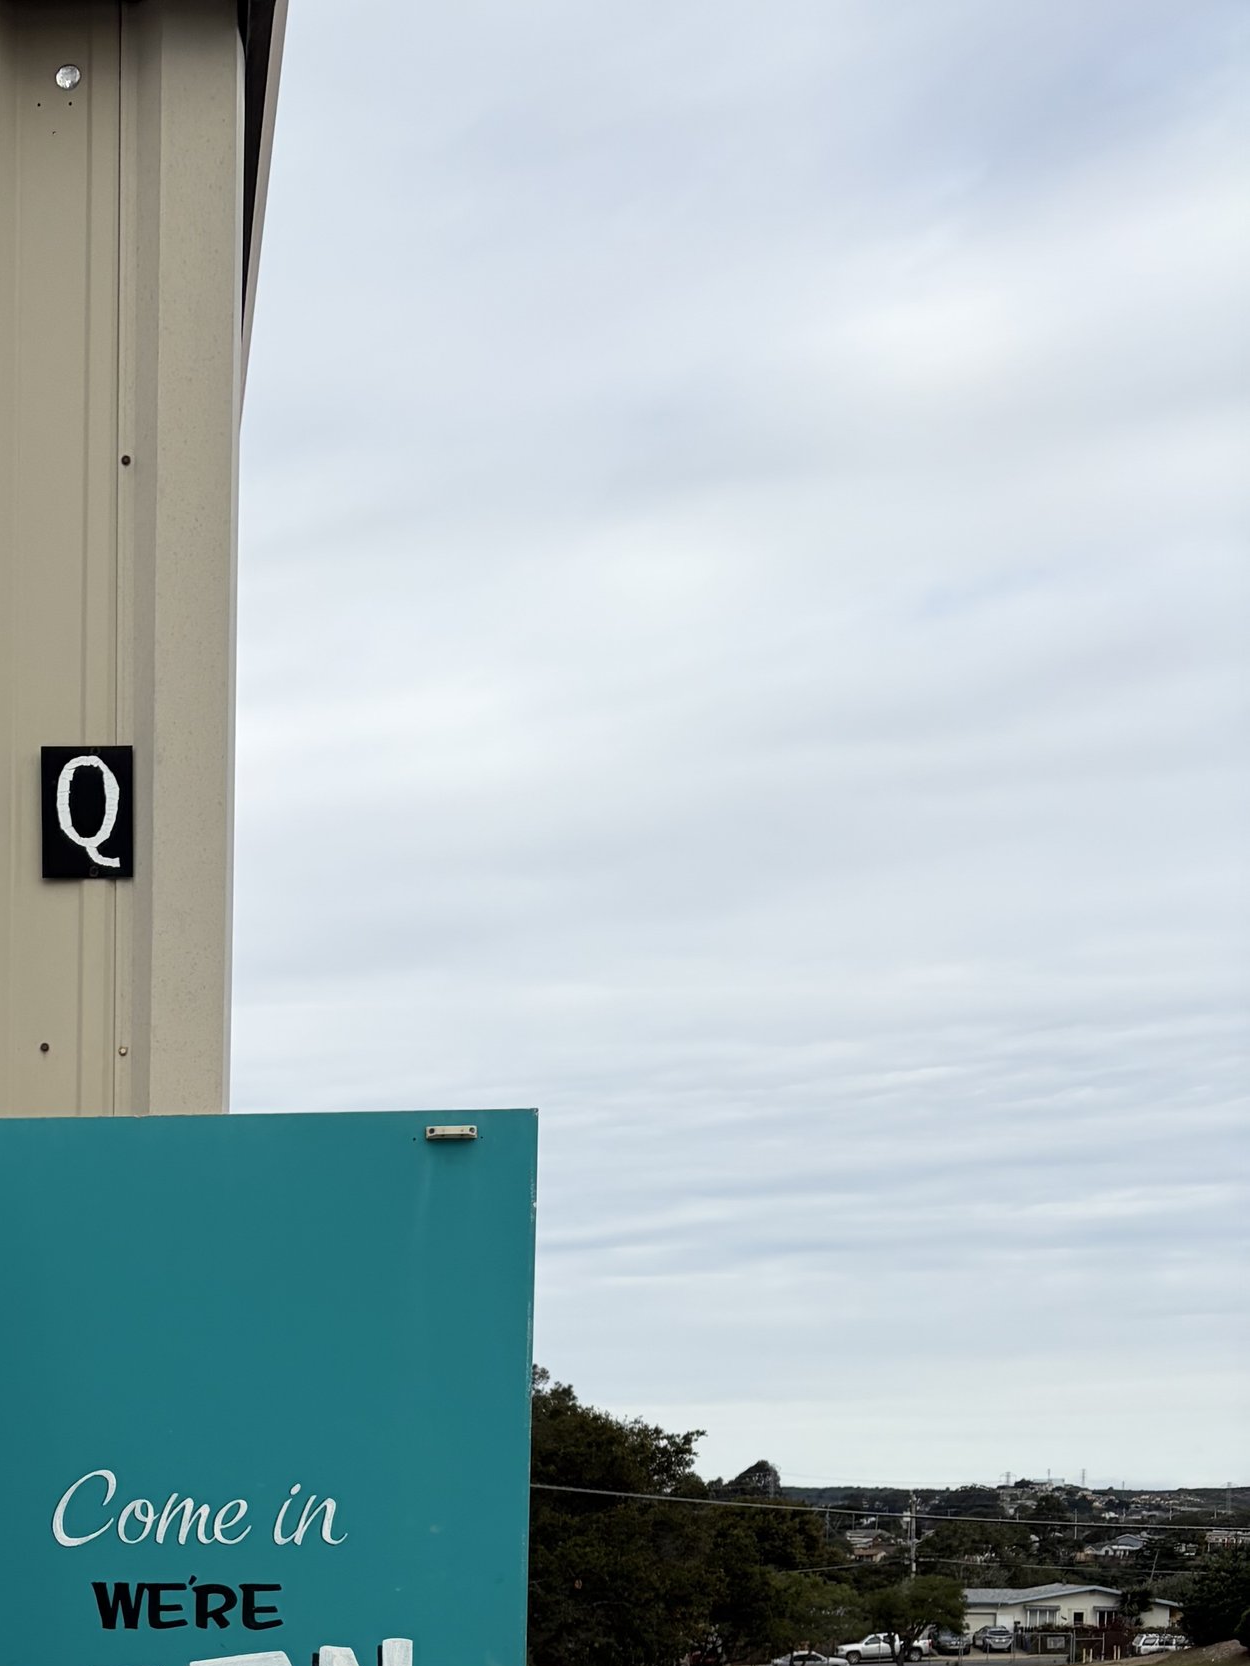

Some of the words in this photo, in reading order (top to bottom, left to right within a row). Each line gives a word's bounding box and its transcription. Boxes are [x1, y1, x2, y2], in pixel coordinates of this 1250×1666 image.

[56, 755, 121, 868] Q
[51, 1469, 251, 1547] Come
[273, 1483, 348, 1546] in
[91, 1575, 284, 1630] WE'RE
